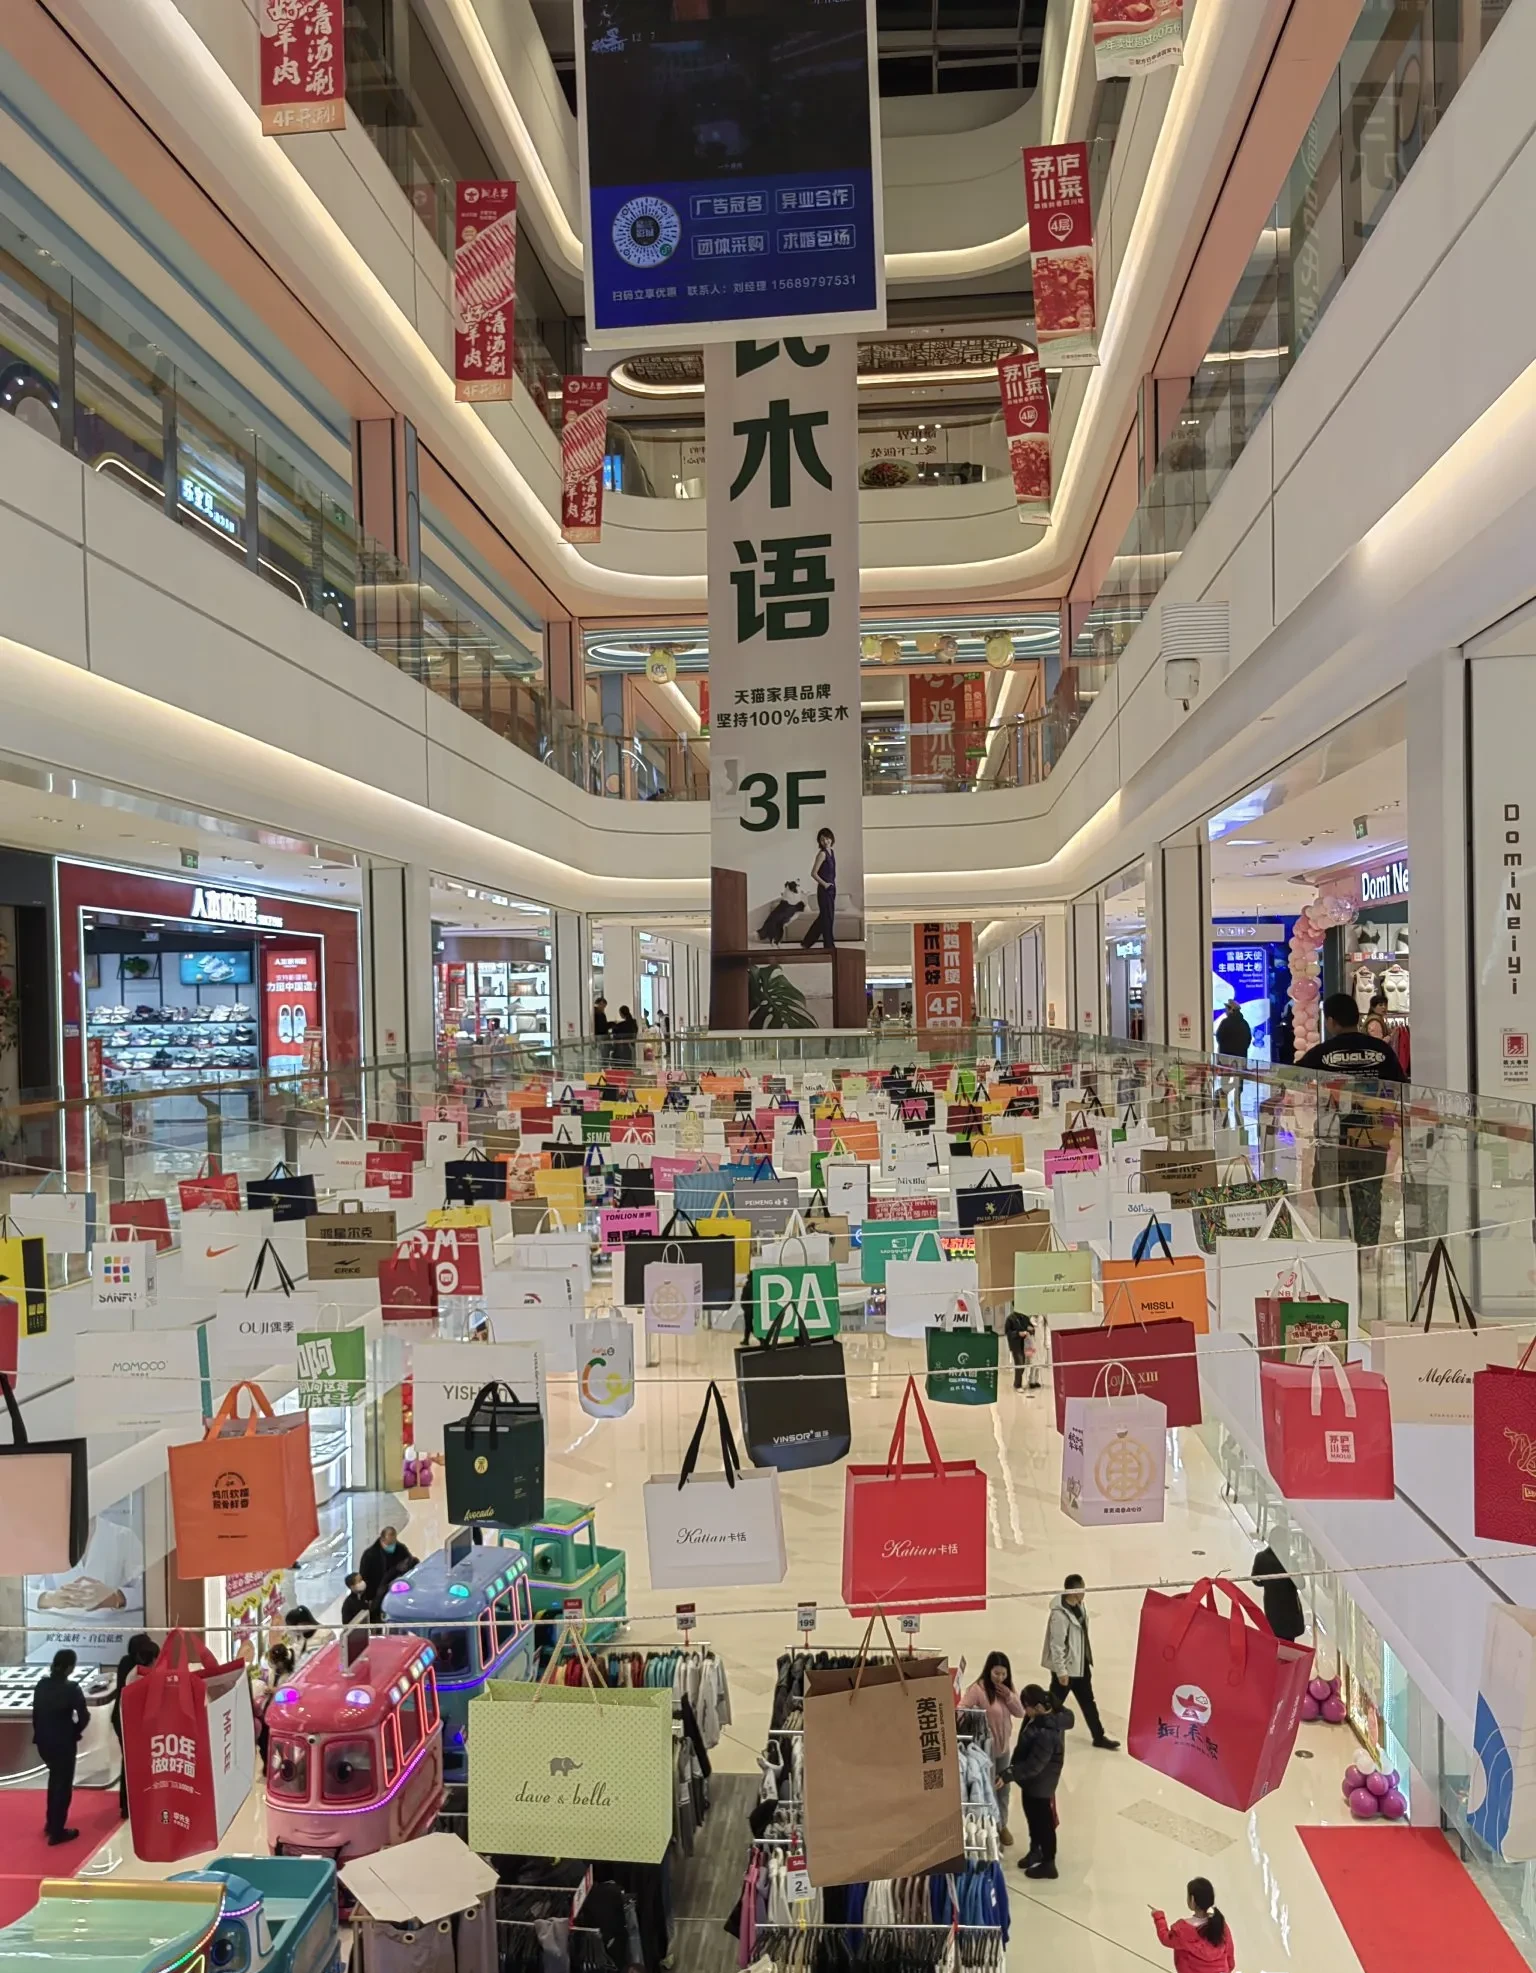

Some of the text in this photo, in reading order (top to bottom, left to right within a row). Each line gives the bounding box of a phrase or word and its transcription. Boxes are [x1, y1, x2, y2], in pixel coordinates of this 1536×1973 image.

[1033, 175, 1084, 202] 川菜
[696, 195, 763, 216] 广告冠名
[781, 189, 849, 210] 异业合作
[1051, 219, 1071, 232] 4层
[697, 235, 765, 256] 团体采购
[783, 230, 850, 250] 求婚包场
[771, 273, 857, 292] 15689797531
[734, 683, 831, 705] 天猫家具品牌
[716, 704, 849, 729] 坚持100%纯实木
[738, 769, 827, 832] 3F
[1362, 866, 1391, 901] Domi
[929, 996, 959, 1015] 4F
[897, 1177, 926, 1185] MixBlu
[606, 1212, 638, 1221] TONLION
[319, 1226, 373, 1240] 鸿星尔克
[1141, 1300, 1175, 1312] MISSLI
[1137, 1371, 1158, 1384] XIII
[773, 1432, 811, 1445] VINSOR
[463, 1505, 495, 1522] Avocado
[916, 1697, 942, 1764] 英茁体育
[150, 1733, 196, 1760] 50年
[150, 1757, 196, 1778] 做好面
[223, 1745, 232, 1776] LEE
[514, 1780, 551, 1806] dave
[572, 1781, 612, 1808] bella
